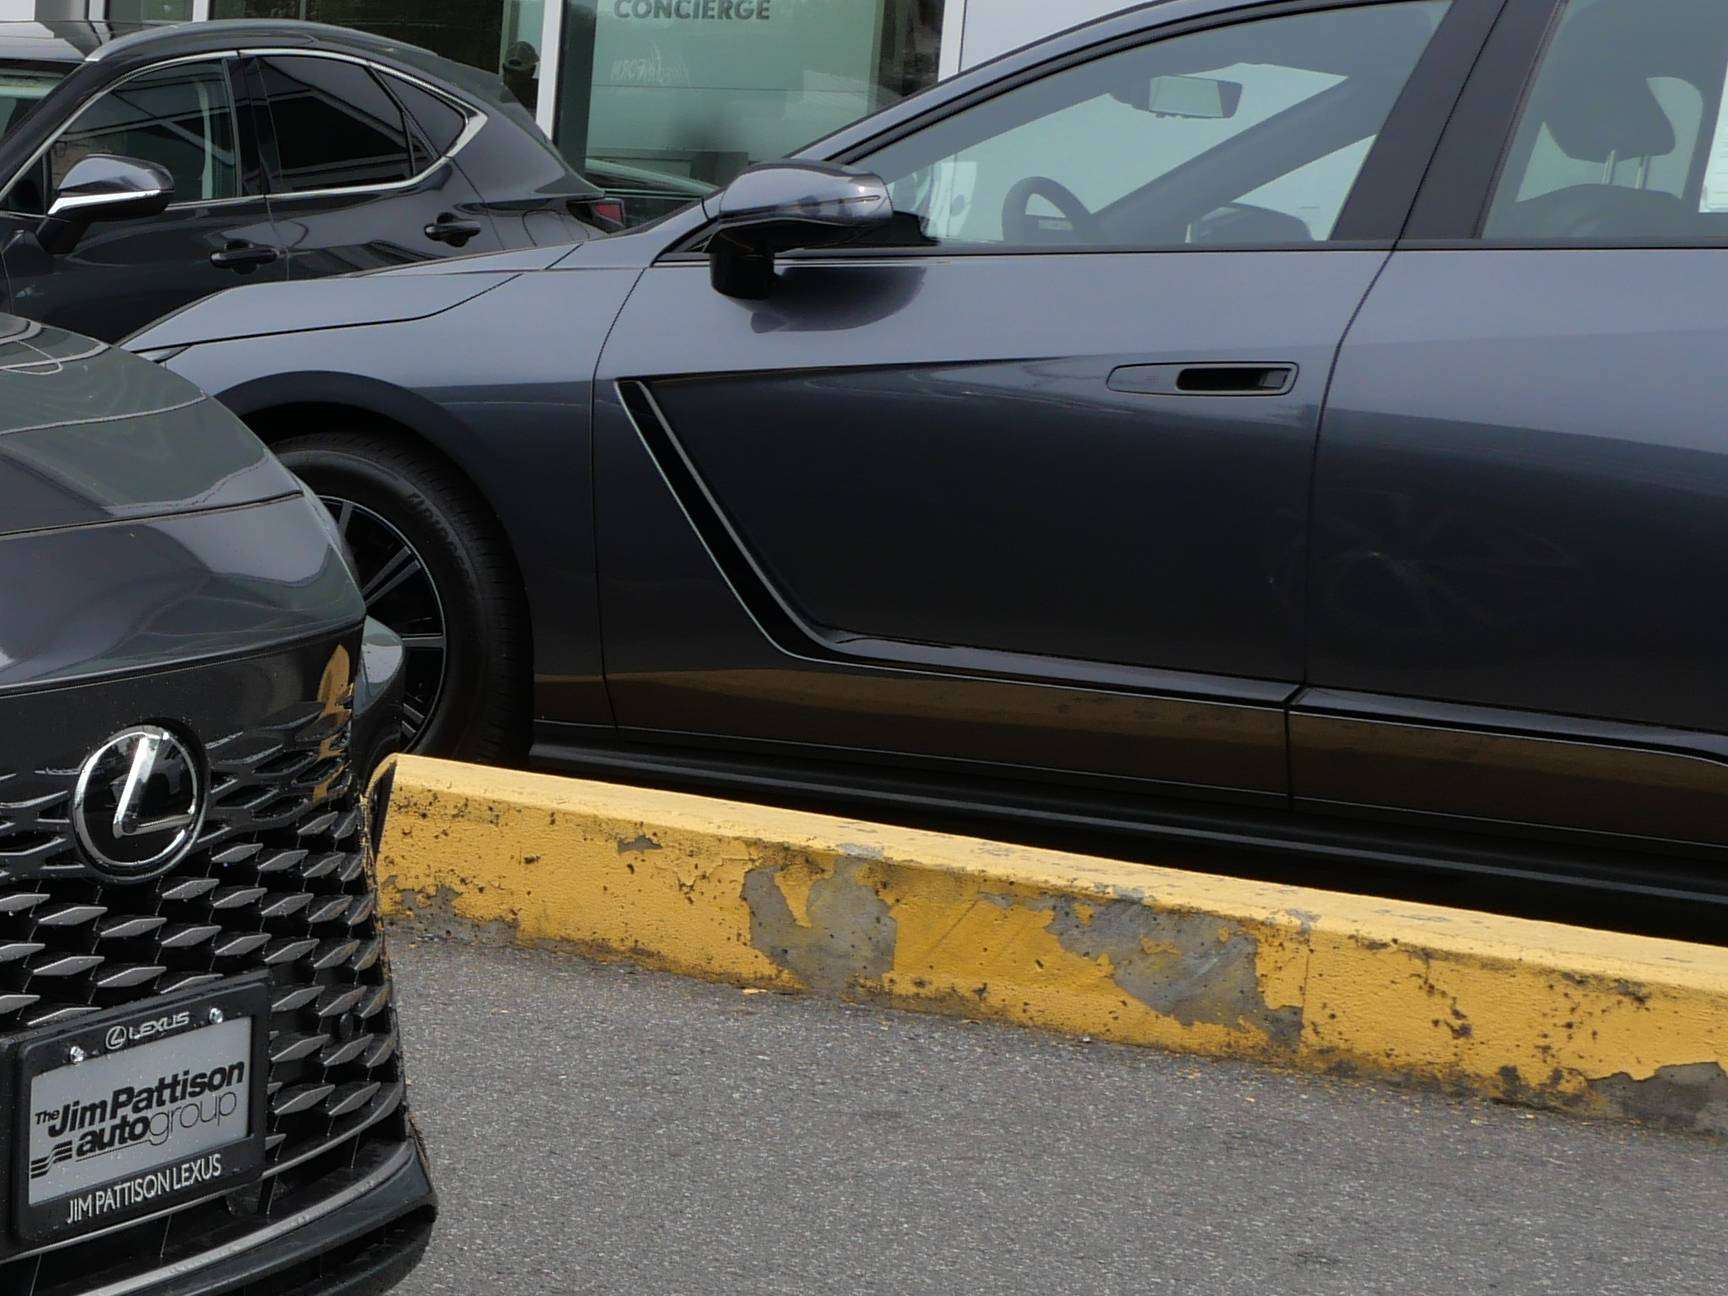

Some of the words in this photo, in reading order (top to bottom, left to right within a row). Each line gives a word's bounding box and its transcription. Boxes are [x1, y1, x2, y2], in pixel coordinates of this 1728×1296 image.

[128, 1011, 191, 1040] LEXUS
[34, 1107, 60, 1125] The
[48, 1098, 108, 1138] Jim
[109, 1060, 245, 1122] Pattison
[65, 1193, 94, 1225] JIM
[94, 1171, 171, 1216] PATTISON
[171, 1153, 223, 1188] LEXUS
